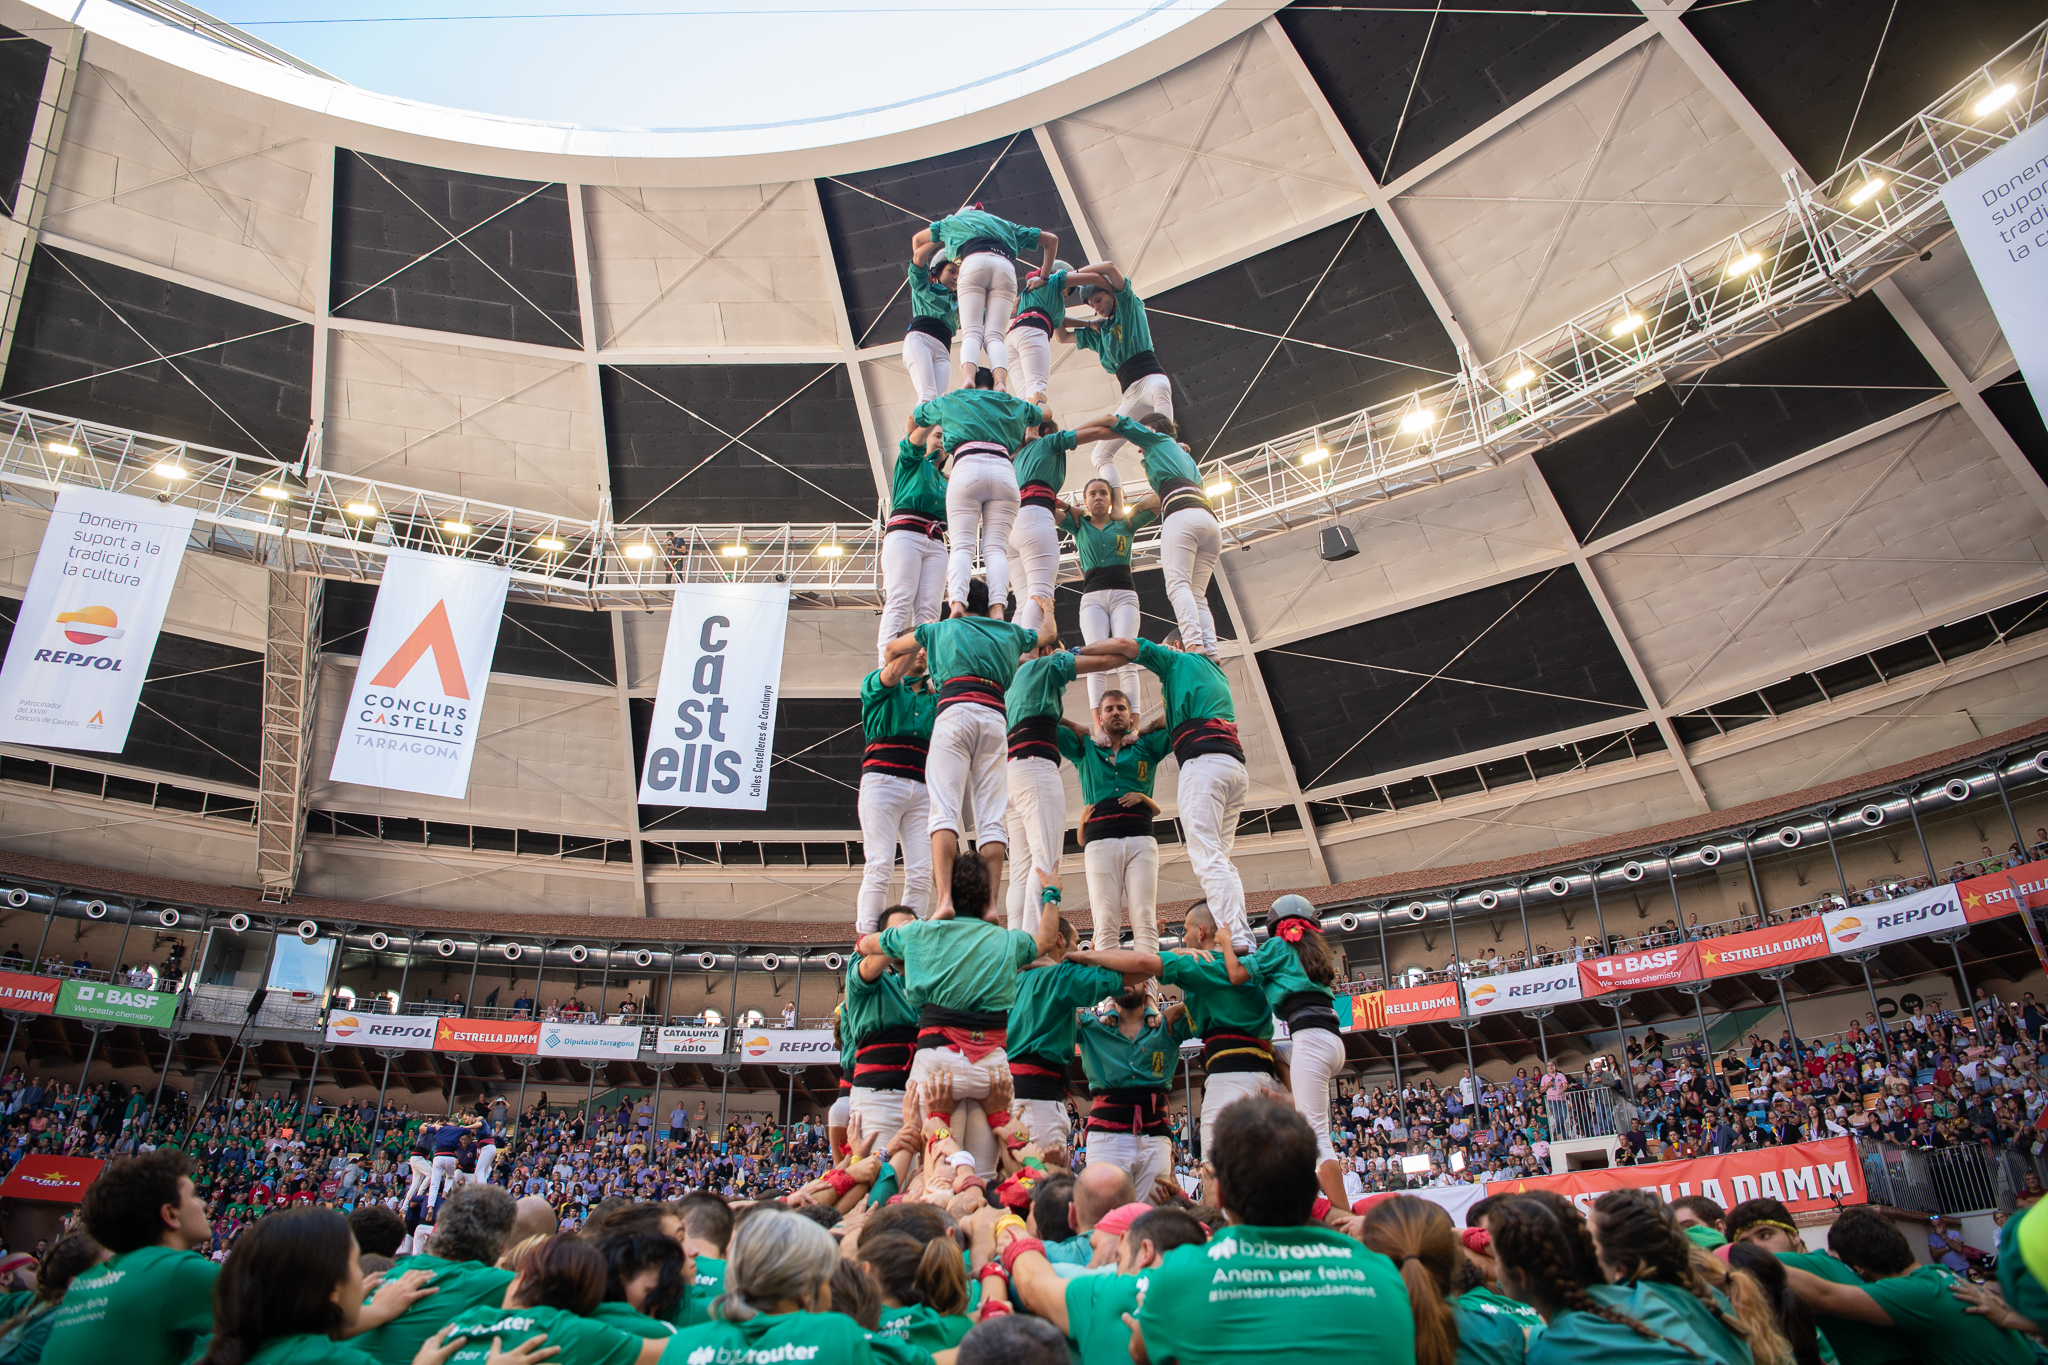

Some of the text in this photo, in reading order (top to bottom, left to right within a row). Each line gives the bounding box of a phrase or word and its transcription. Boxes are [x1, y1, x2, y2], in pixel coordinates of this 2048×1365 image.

[1992, 180, 2048, 226] supor
[1999, 204, 2048, 243] tradi
[2008, 244, 2030, 262] la
[78, 511, 138, 533] Donem
[73, 529, 161, 555] suport a la
[69, 545, 139, 568] tradició i
[63, 561, 141, 587] la cultura
[33, 648, 122, 672] REPSOL
[20, 699, 62, 709] Patrocinador
[364, 693, 467, 721] CONCURS
[14, 714, 41, 722] Concurs
[52, 718, 79, 727] Castells
[360, 710, 464, 738] CASTELLS
[355, 733, 459, 760] TARRAGONA
[749, 685, 773, 797] Colles Castelleres de Catalunya
[1984, 877, 2048, 905] ESTELL
[1877, 900, 1959, 930] REPSOL
[1720, 932, 1825, 963] ESTRELLA DAMM
[1624, 949, 1678, 973] BASF
[1508, 977, 1577, 997] REPSOL
[1599, 970, 1682, 988] We create chemistry
[14, 988, 54, 1003] DAMM
[105, 989, 160, 1009] BASF
[1386, 996, 1456, 1015] RELLA DAMM
[74, 1004, 154, 1022] We create chemistry
[368, 1024, 432, 1038] REPSOL
[453, 1031, 537, 1044] ESTRELLA DAMM
[663, 1029, 720, 1038] CATALUNYA
[564, 1037, 635, 1048] Diputació Tarragona
[1672, 1048, 1686, 1057] BA
[20, 1175, 80, 1186] ESTRELLA
[1731, 1160, 1854, 1210] DAMM
[1239, 1237, 1353, 1260] b2brouter
[1212, 1265, 1367, 1284] Anem per feina
[453, 1350, 481, 1361] per
